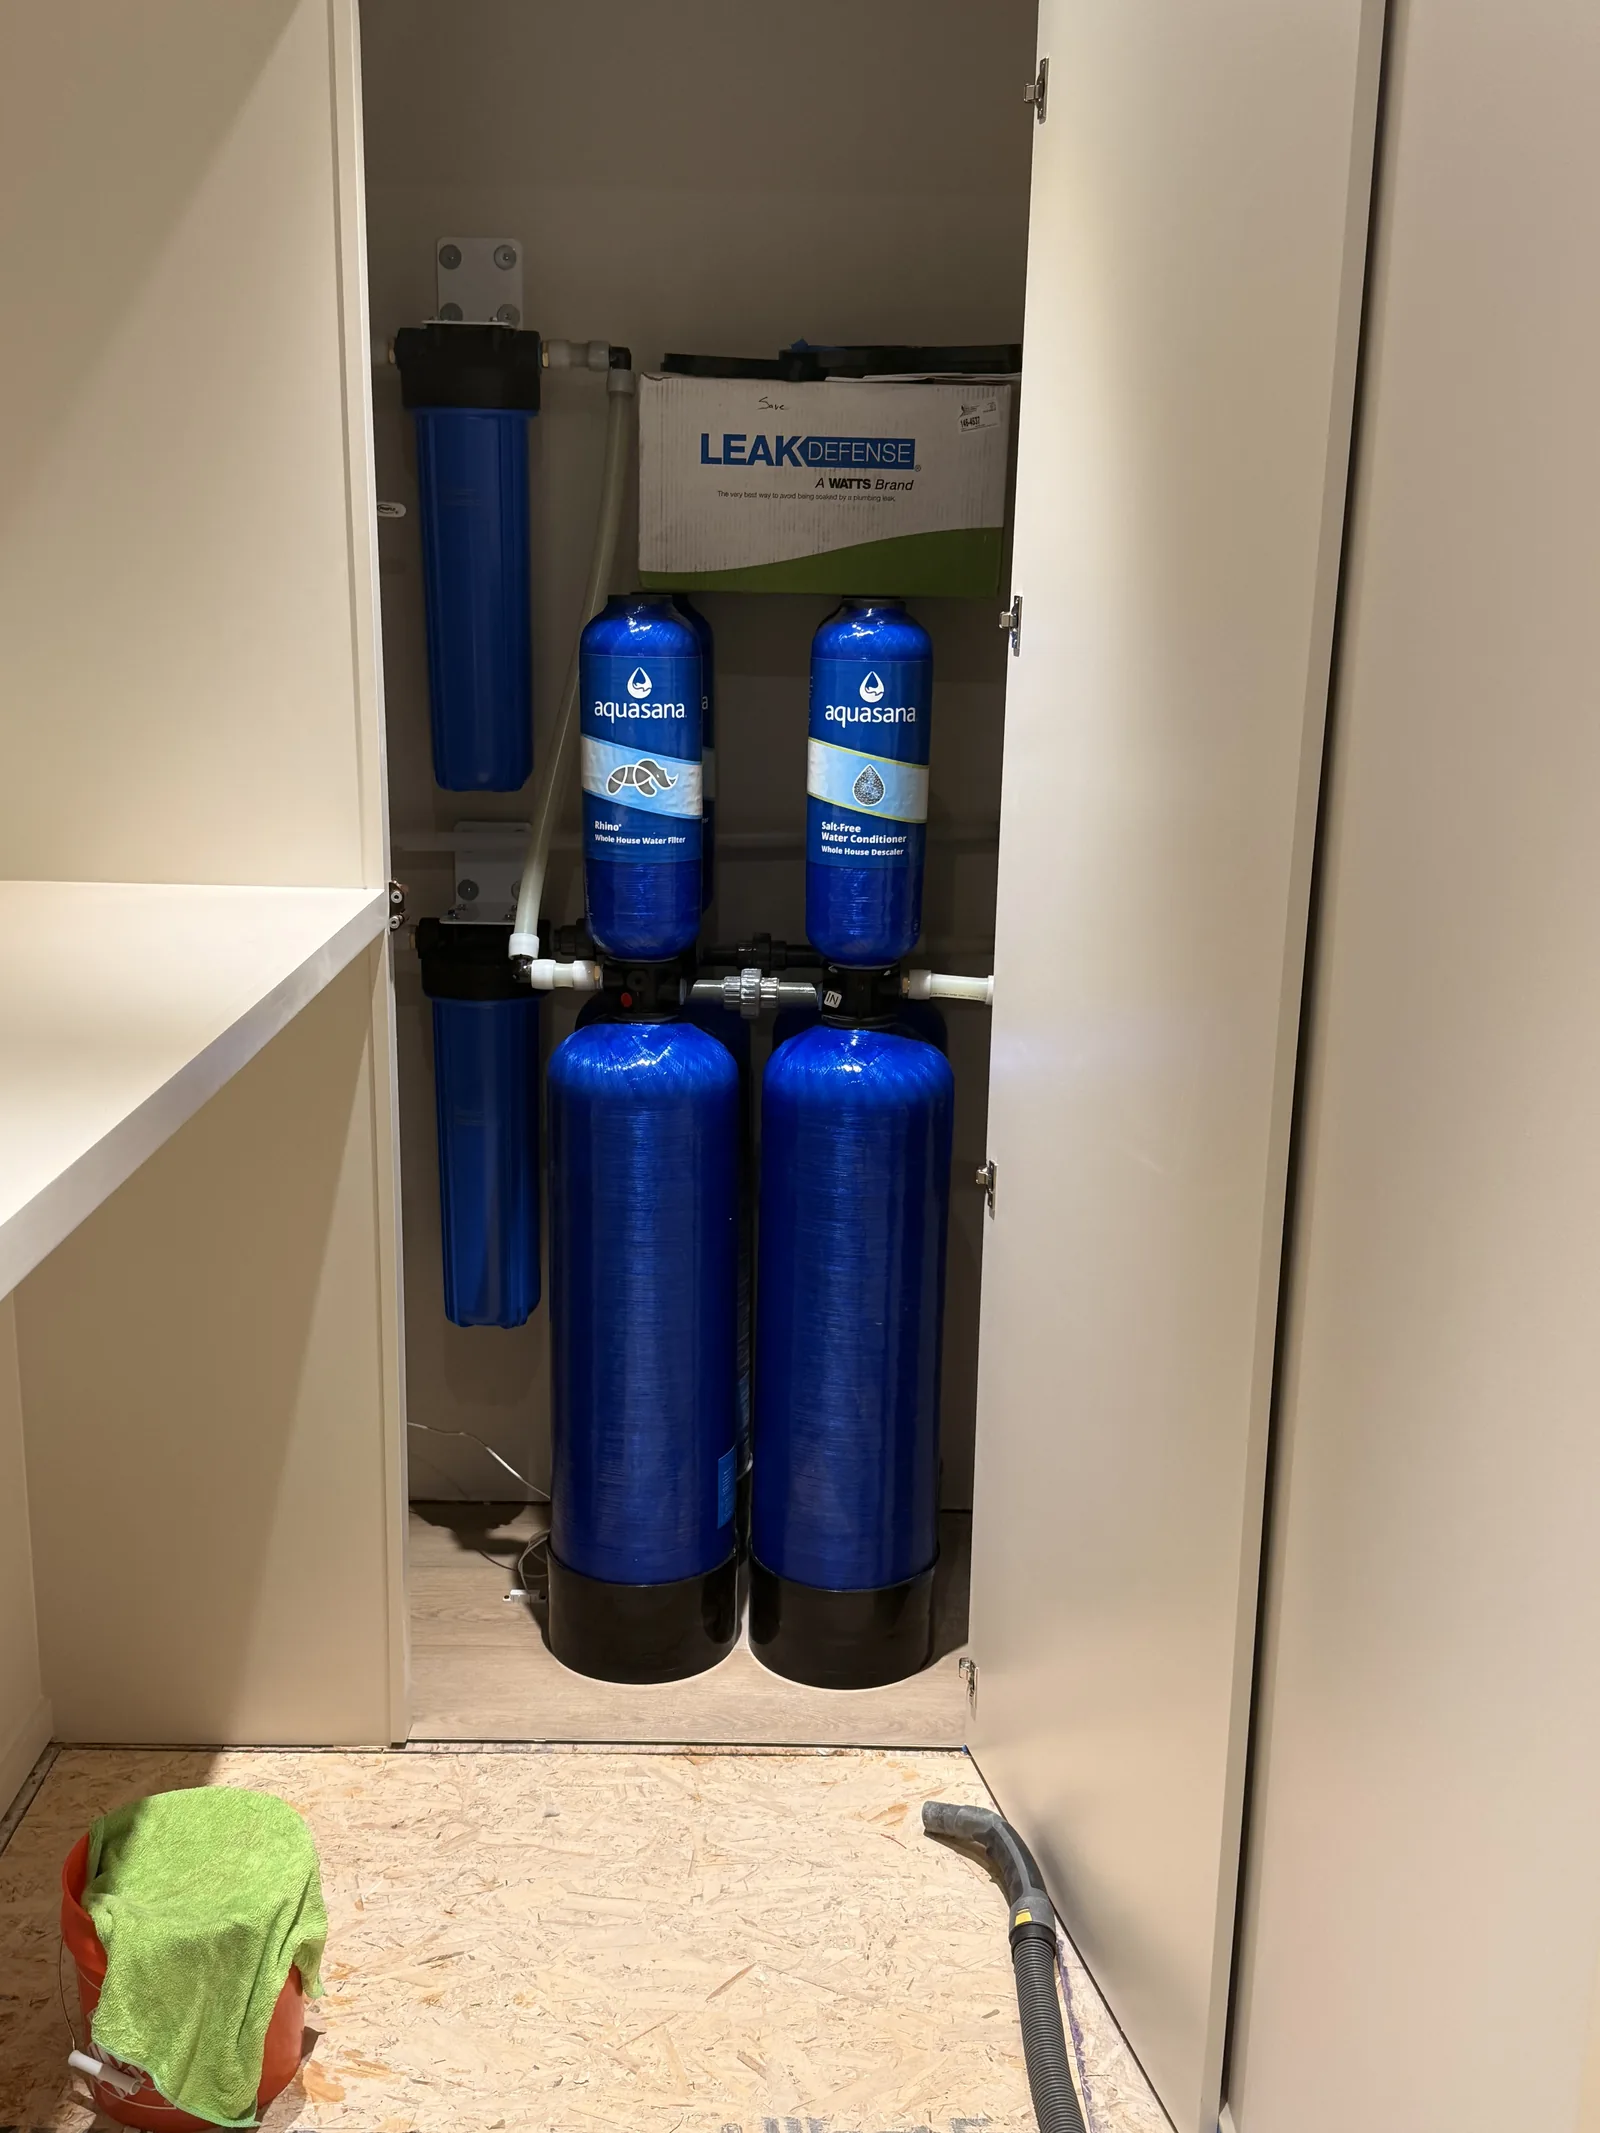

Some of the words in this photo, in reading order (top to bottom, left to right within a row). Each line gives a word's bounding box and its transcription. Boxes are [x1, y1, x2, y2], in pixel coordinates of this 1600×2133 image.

[700, 433, 803, 467] LEAK
[807, 441, 912, 463] DEFENSE
[815, 478, 825, 489] A
[829, 477, 871, 489] WATTS
[875, 479, 914, 491] Brand
[717, 490, 729, 498] The
[730, 491, 743, 499] very
[759, 492, 771, 500] way
[797, 492, 815, 501] being
[816, 493, 837, 501] soaked
[839, 493, 847, 501] by
[853, 494, 881, 502] plumbing
[594, 701, 686, 724] aquasana
[825, 704, 916, 728] aquasana
[821, 821, 861, 833] Salt-Free
[594, 834, 615, 843] Whole
[642, 837, 667, 845] Water
[667, 836, 686, 844] Filter
[821, 831, 848, 843] Water
[850, 835, 907, 844] Conditioner
[821, 845, 843, 855] Whole
[844, 847, 870, 856] House
[871, 848, 904, 856] Descaler
[825, 992, 839, 1005] IN
